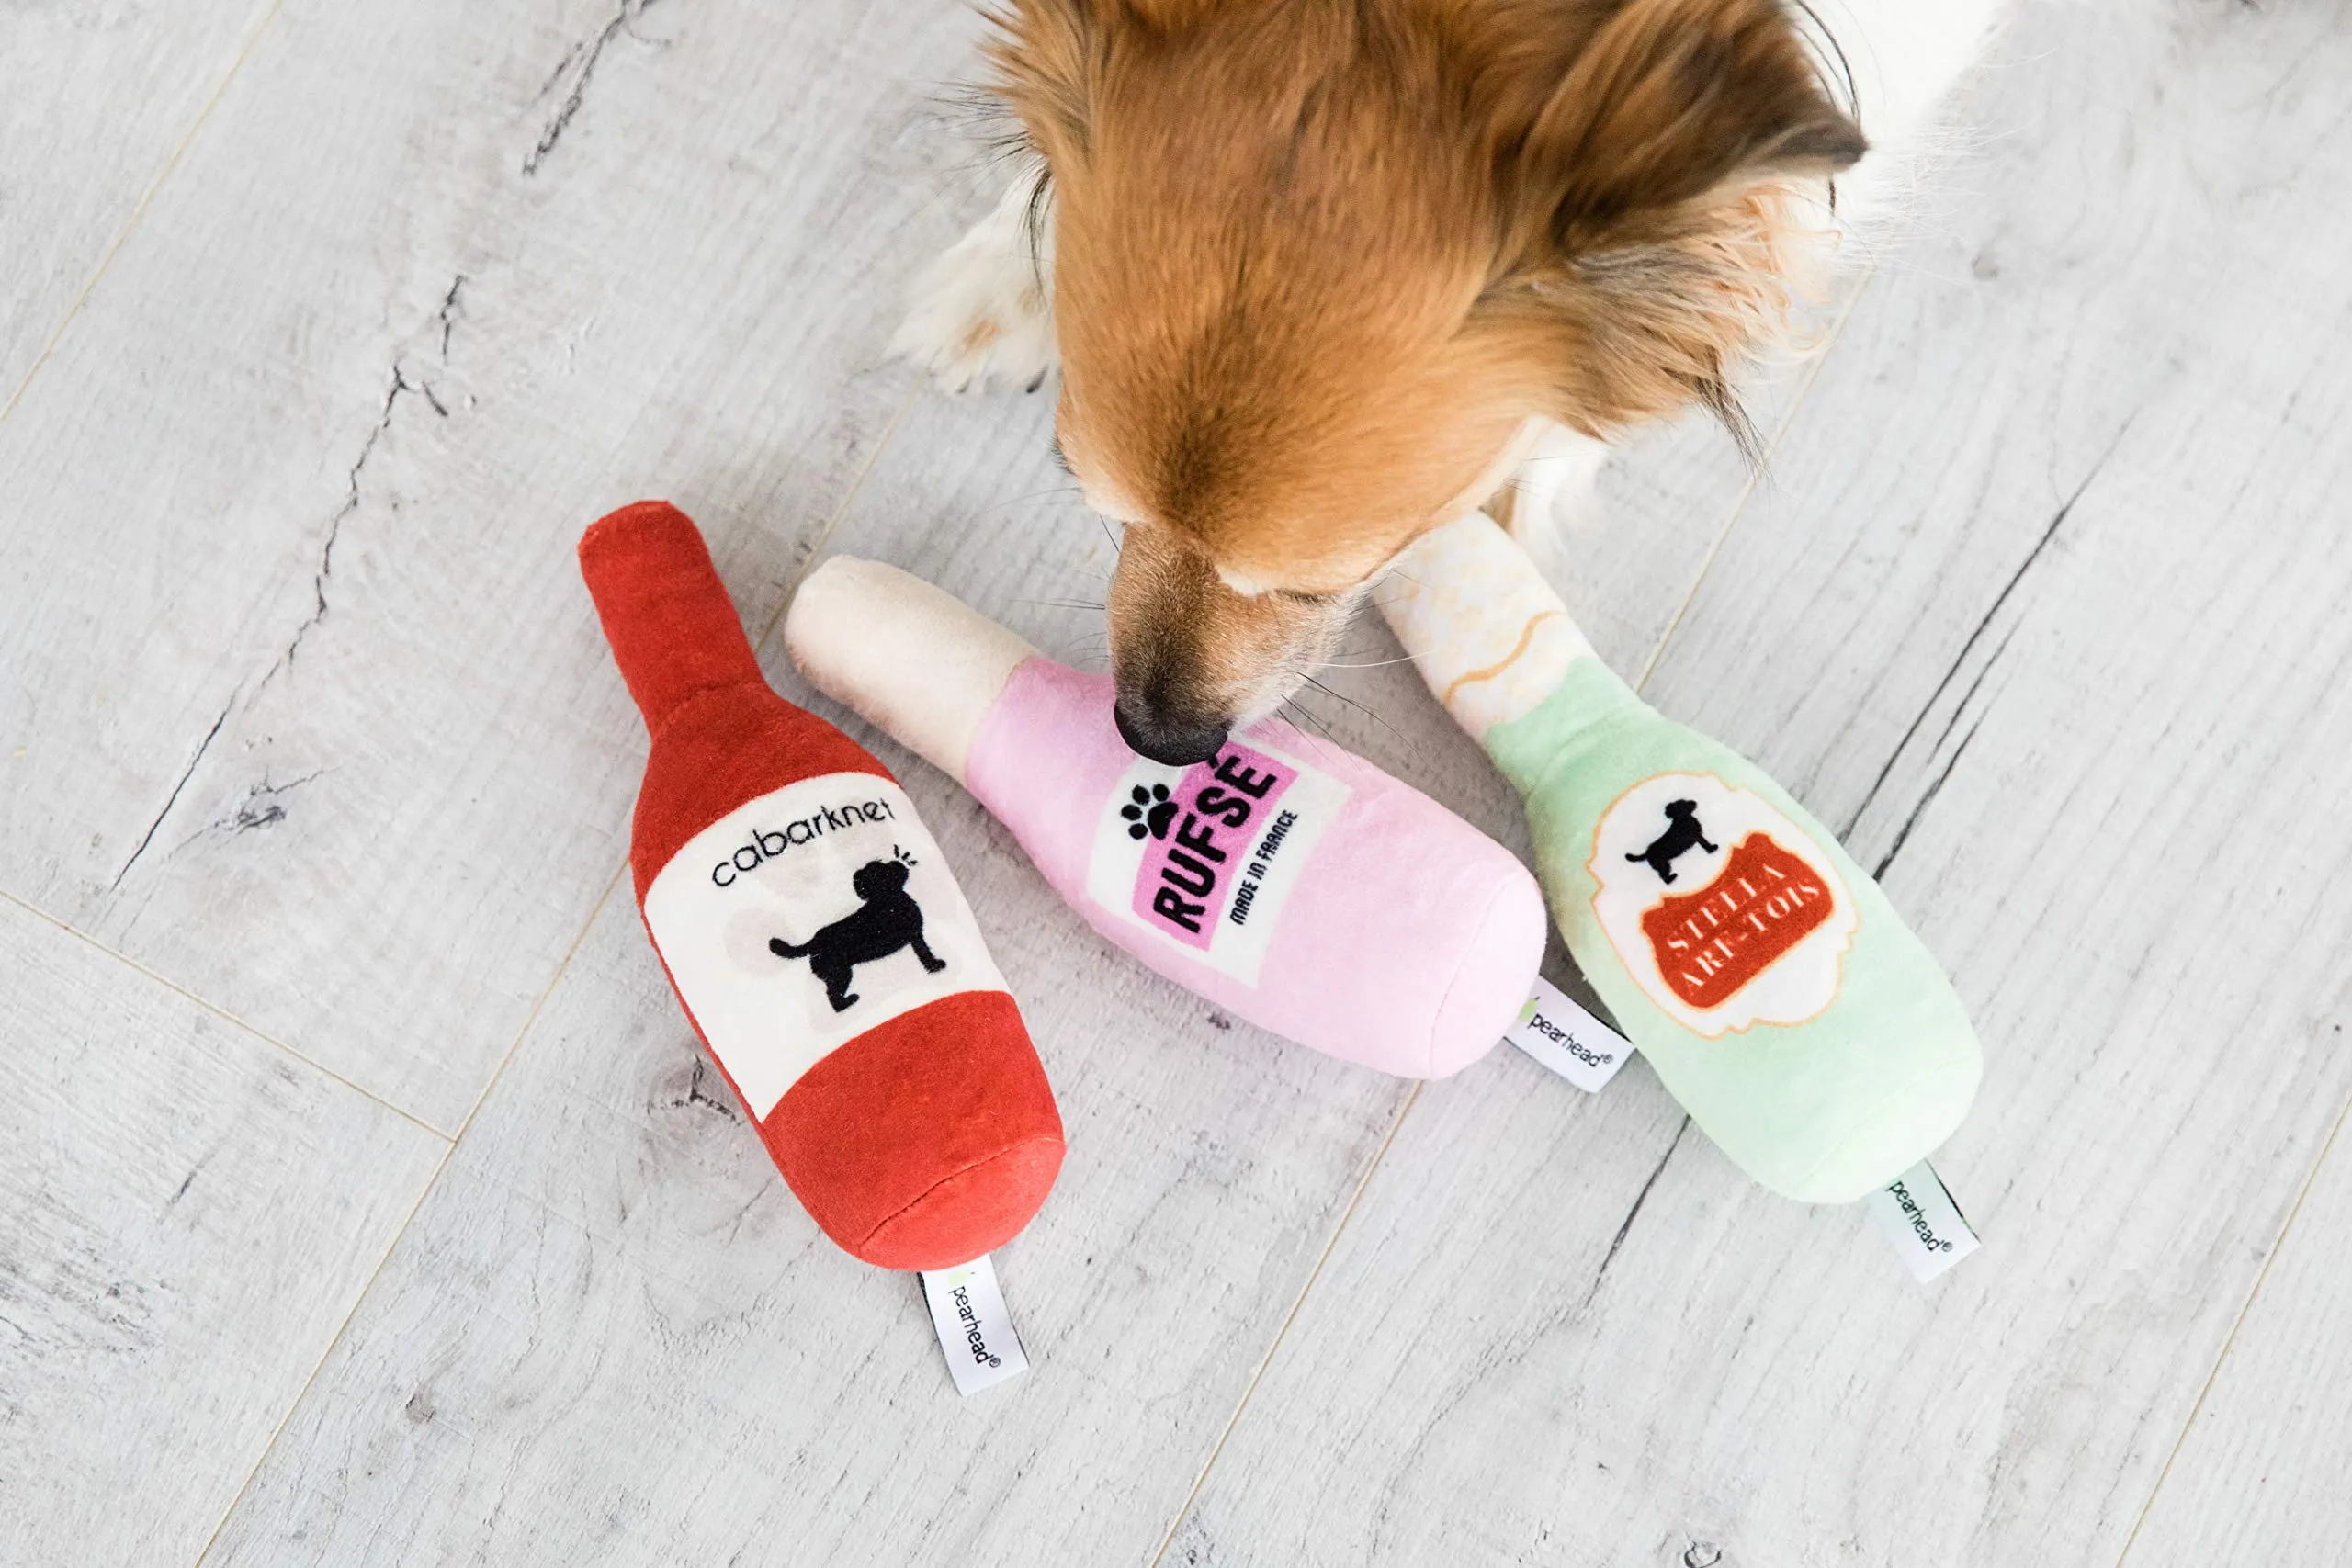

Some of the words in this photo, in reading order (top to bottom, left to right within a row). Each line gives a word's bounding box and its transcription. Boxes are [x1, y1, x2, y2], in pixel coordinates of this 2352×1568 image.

[711, 797, 897, 887] cabarknet
[1255, 809, 1299, 863] FRANCE
[1247, 862, 1267, 881] IN
[1229, 879, 1259, 926] MADE
[1666, 863, 1785, 957] STELLA
